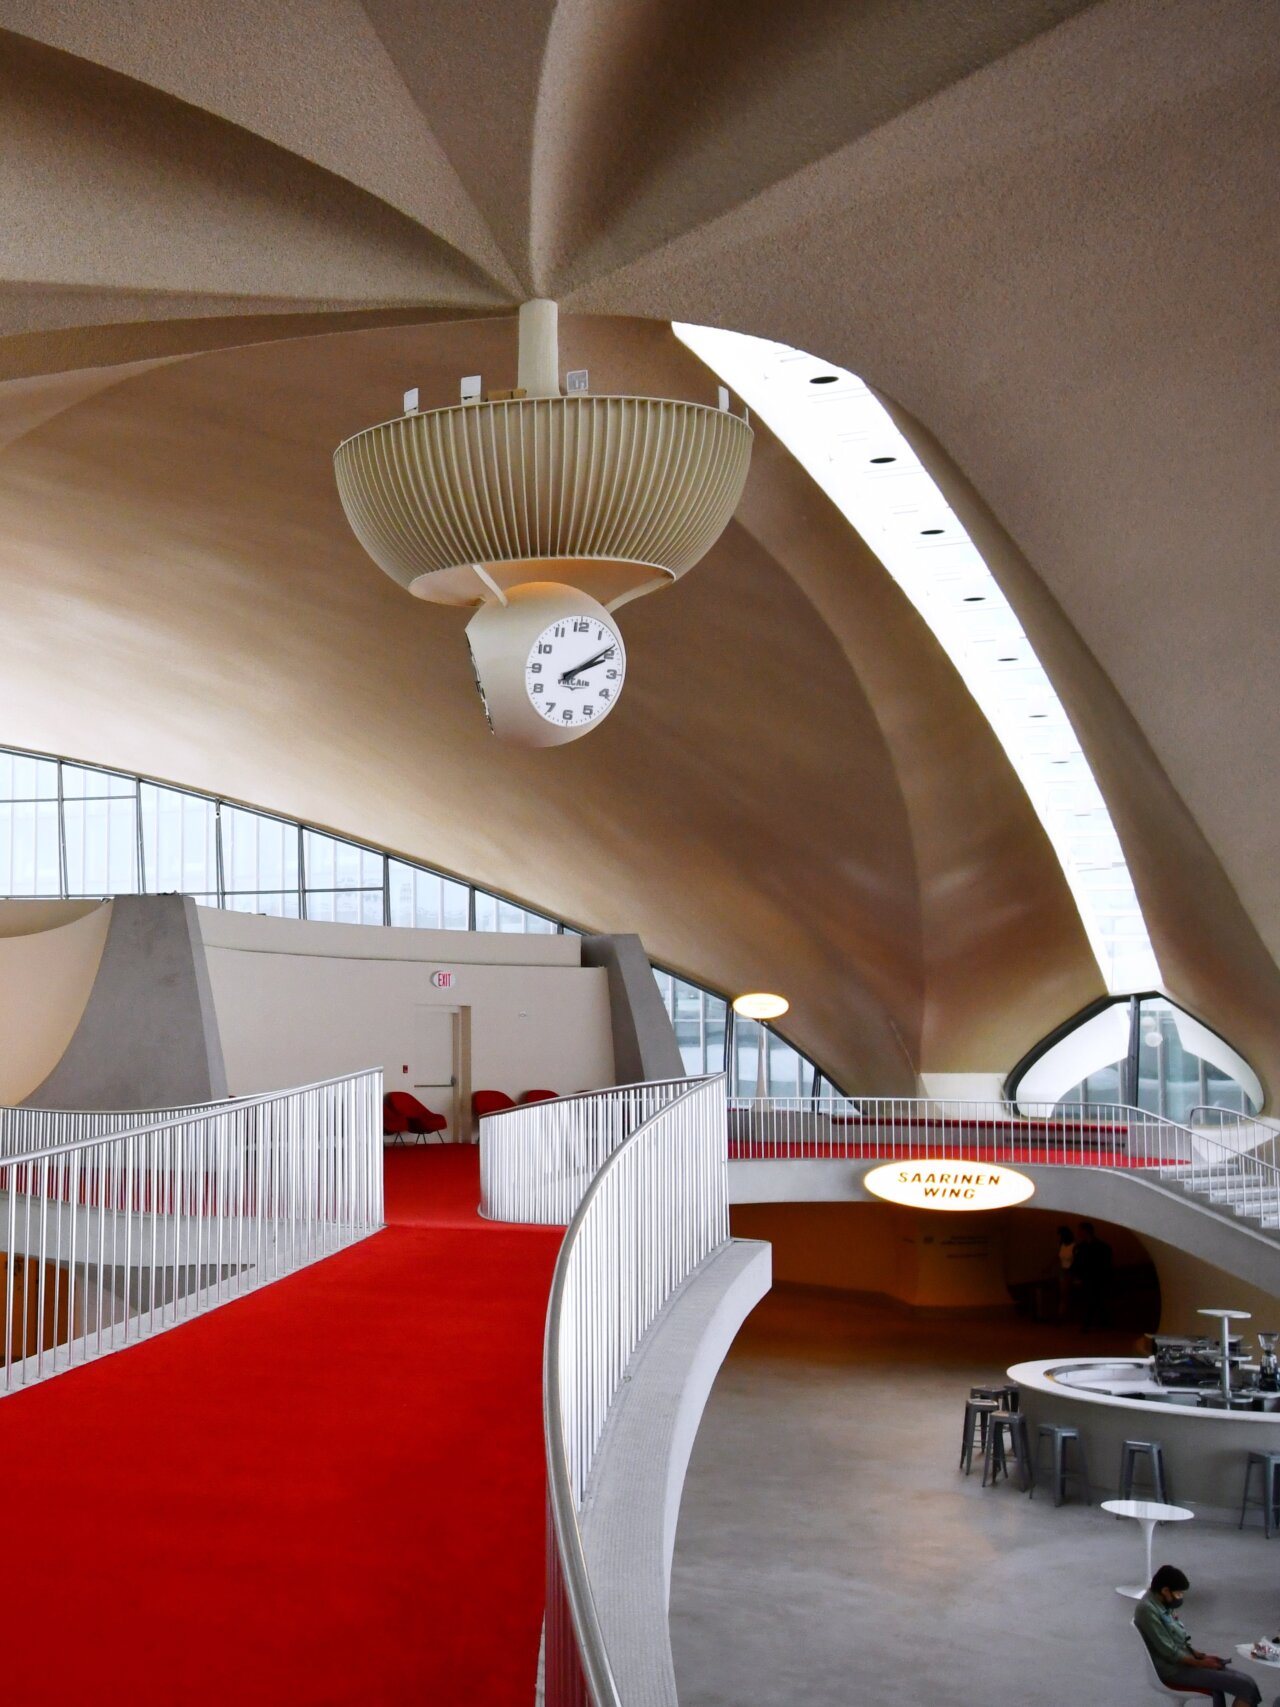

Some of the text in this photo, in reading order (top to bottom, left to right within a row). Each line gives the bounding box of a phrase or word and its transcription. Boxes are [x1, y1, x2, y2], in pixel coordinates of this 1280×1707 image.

[555, 627, 565, 638] 11
[573, 622, 590, 633] 12
[597, 630, 603, 641] 1
[538, 643, 553, 654] 10
[531, 663, 542, 673] 9
[606, 669, 617, 680] 3
[533, 683, 544, 693] 8
[599, 689, 610, 699] 4
[545, 702, 556, 713] 7
[583, 705, 594, 716] 5
[562, 709, 573, 720] 6
[437, 973, 452, 987] EXIT
[897, 1171, 1002, 1186] SAARINEN
[923, 1188, 977, 1200] WING
